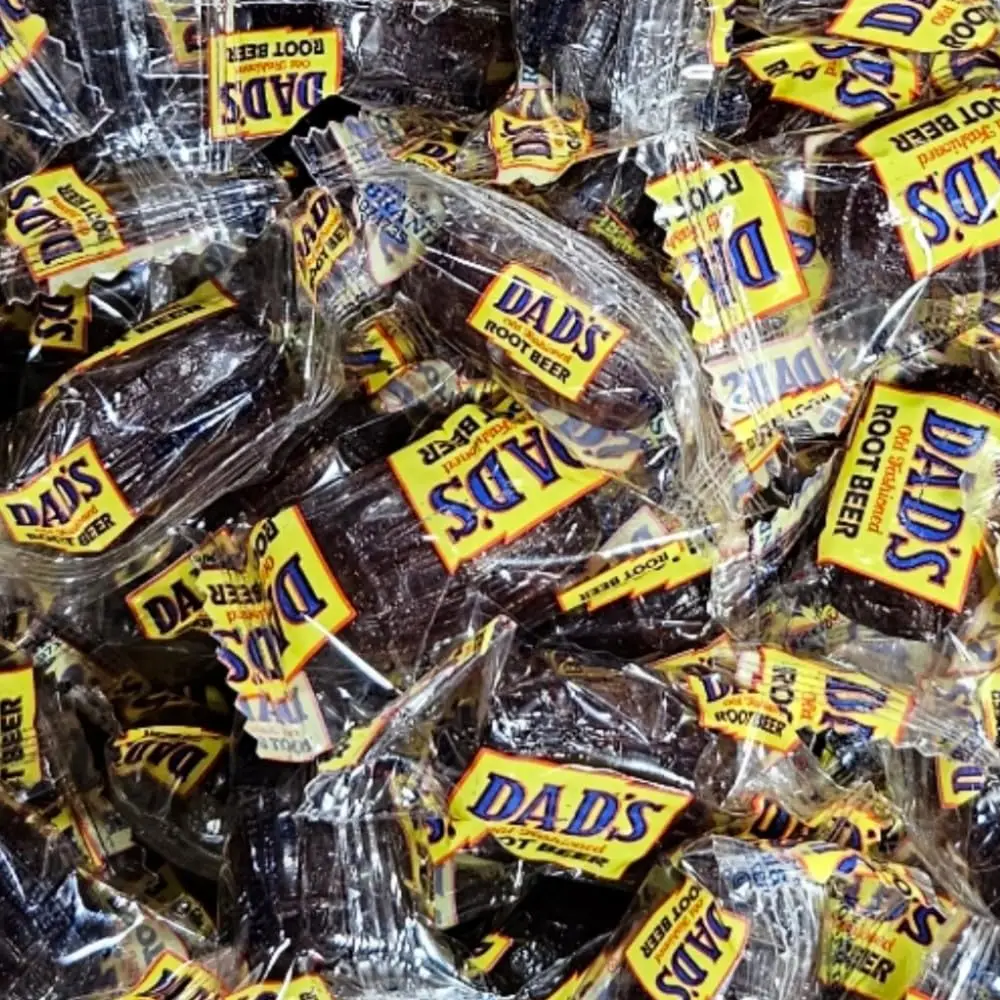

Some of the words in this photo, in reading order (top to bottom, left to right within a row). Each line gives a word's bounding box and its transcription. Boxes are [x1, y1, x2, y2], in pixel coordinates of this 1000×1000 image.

[272, 38, 326, 57] ROOT
[891, 112, 959, 153] BEER
[483, 319, 528, 356] ROOT
[529, 347, 572, 385] BEER
[493, 275, 612, 363] DAD'S
[857, 403, 899, 473] ROOT
[6, 457, 104, 528] DAD'S
[832, 473, 875, 541] BEER
[883, 406, 991, 588] DAD'S
[78, 512, 117, 547] BEER
[621, 551, 670, 582] ROOT
[467, 772, 665, 844] DAD'S
[535, 841, 611, 869] BEER
